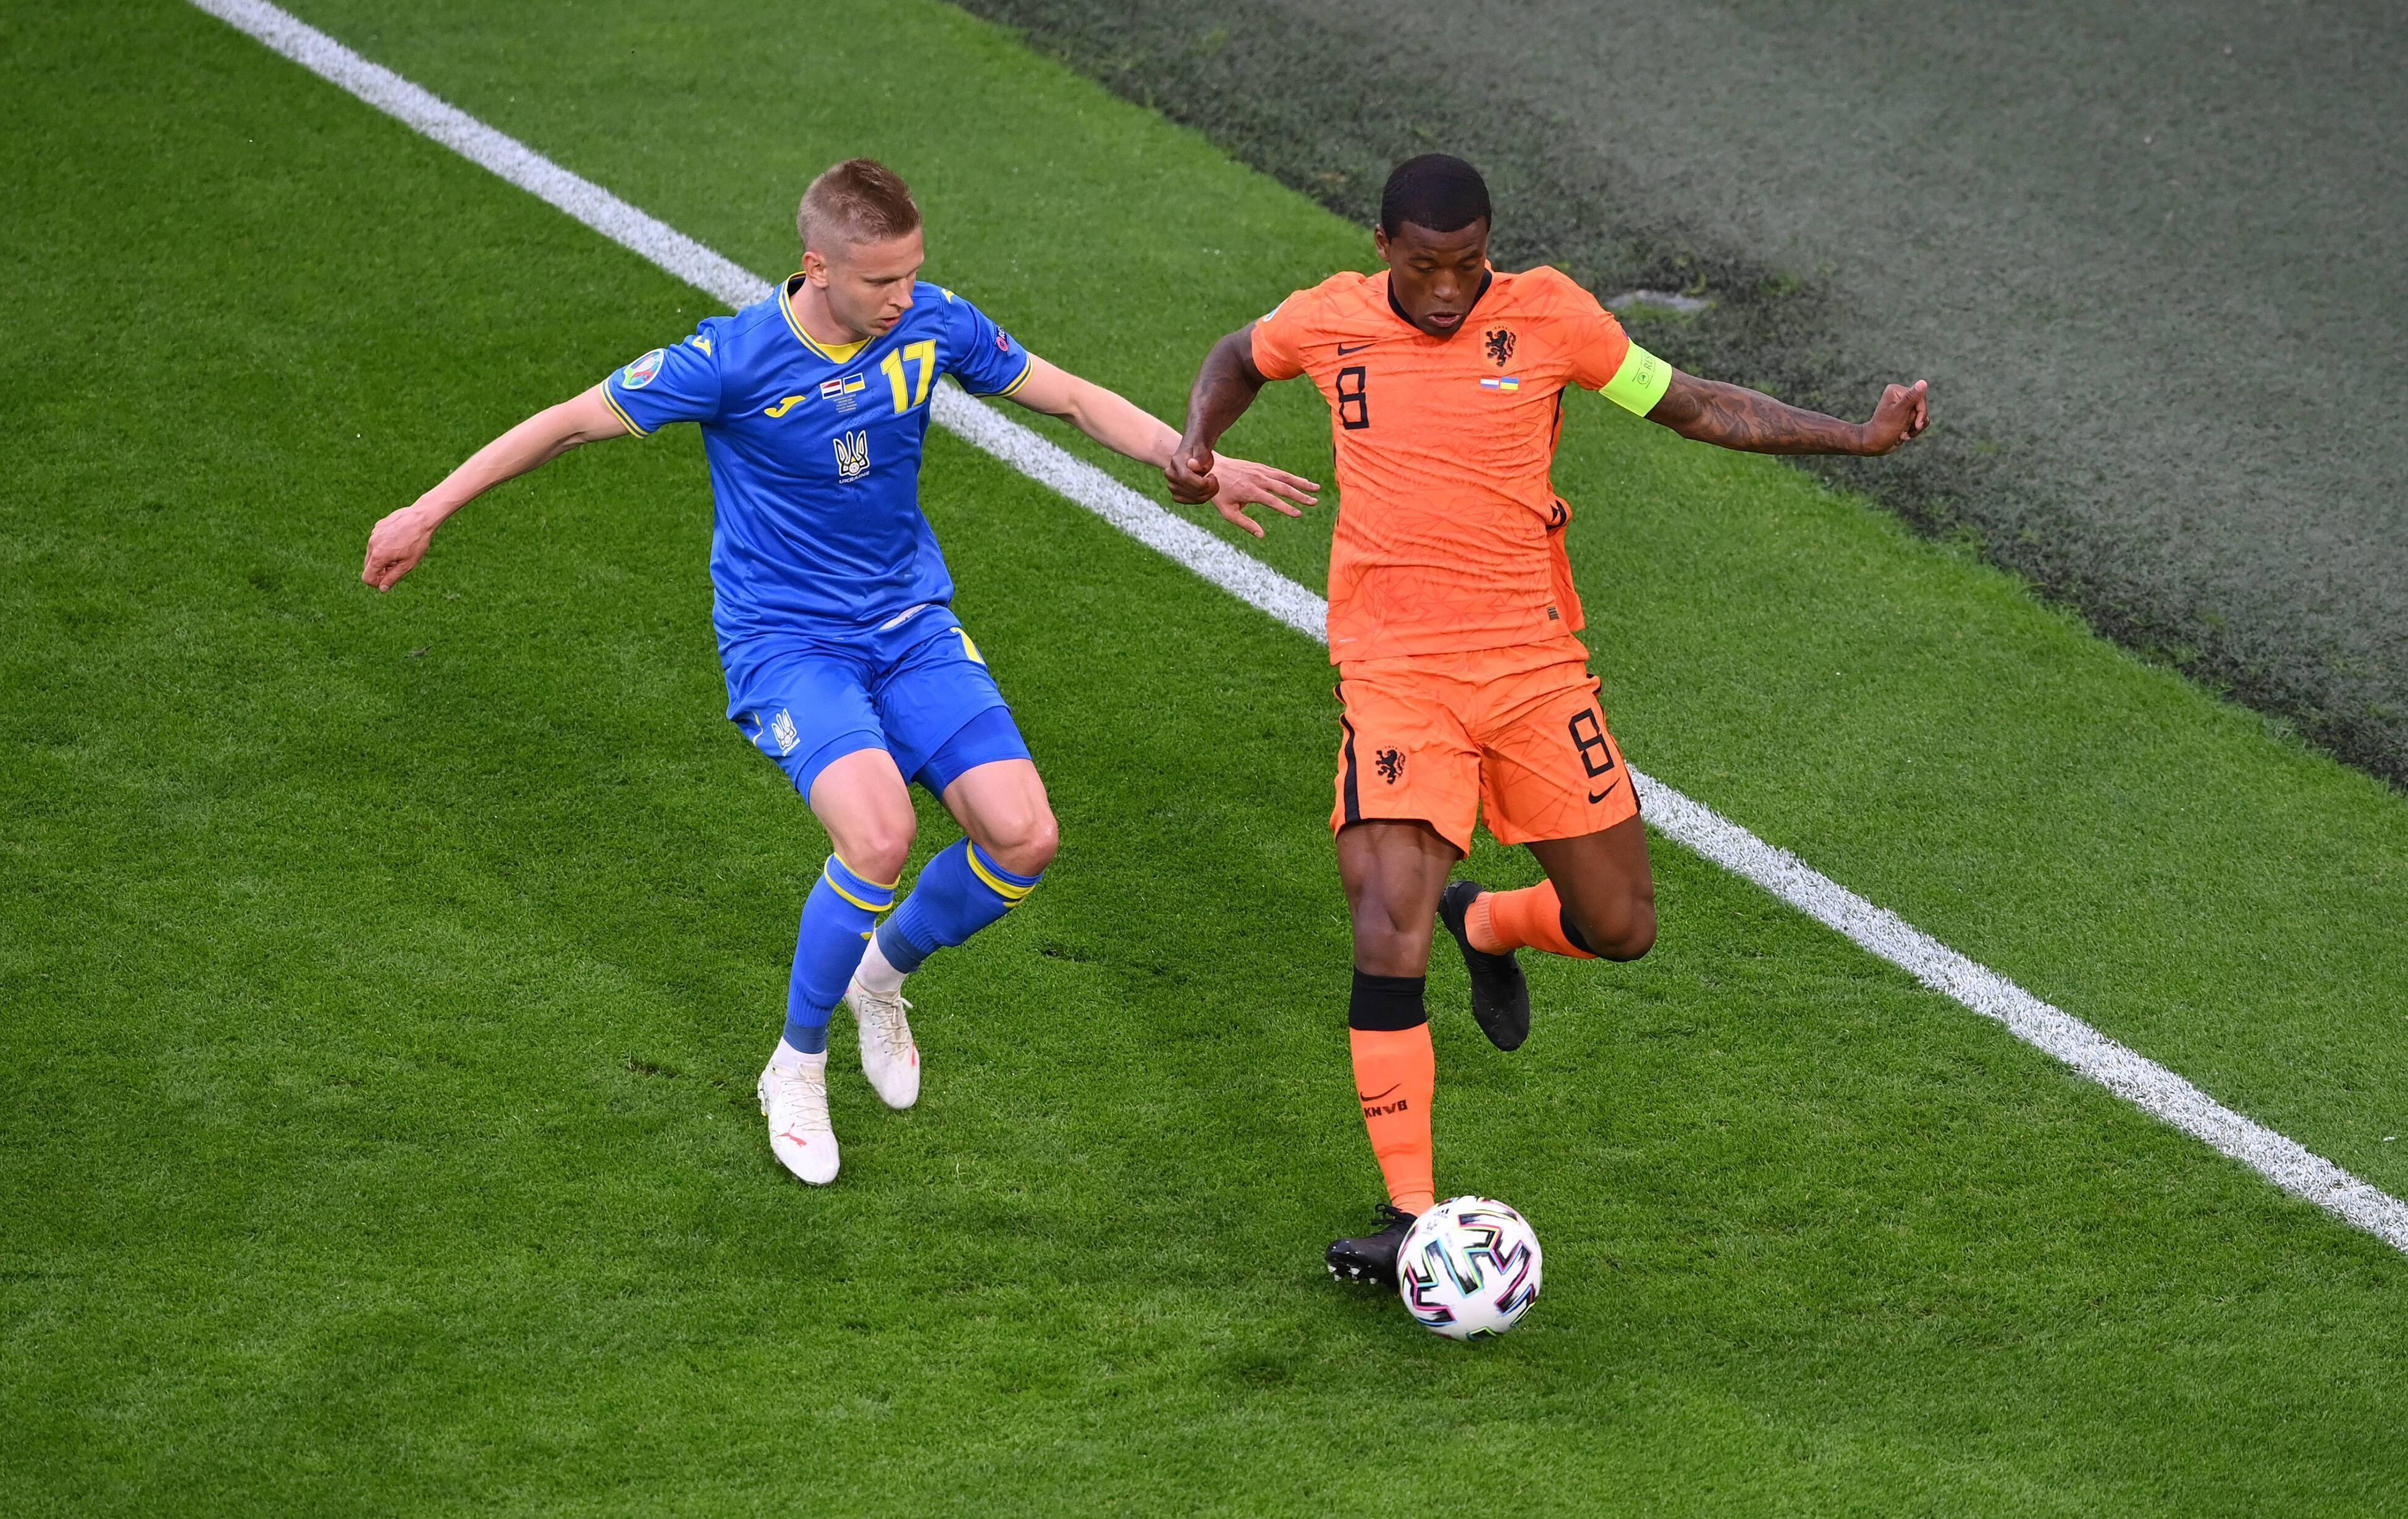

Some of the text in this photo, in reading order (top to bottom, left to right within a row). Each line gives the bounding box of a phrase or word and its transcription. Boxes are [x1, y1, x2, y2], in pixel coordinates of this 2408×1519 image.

[880, 339, 937, 414] 17
[1335, 366, 1370, 430] 8
[839, 470, 870, 484] UKRAINE
[1568, 707, 1615, 779] 8
[1363, 1099, 1408, 1119] KNVB
